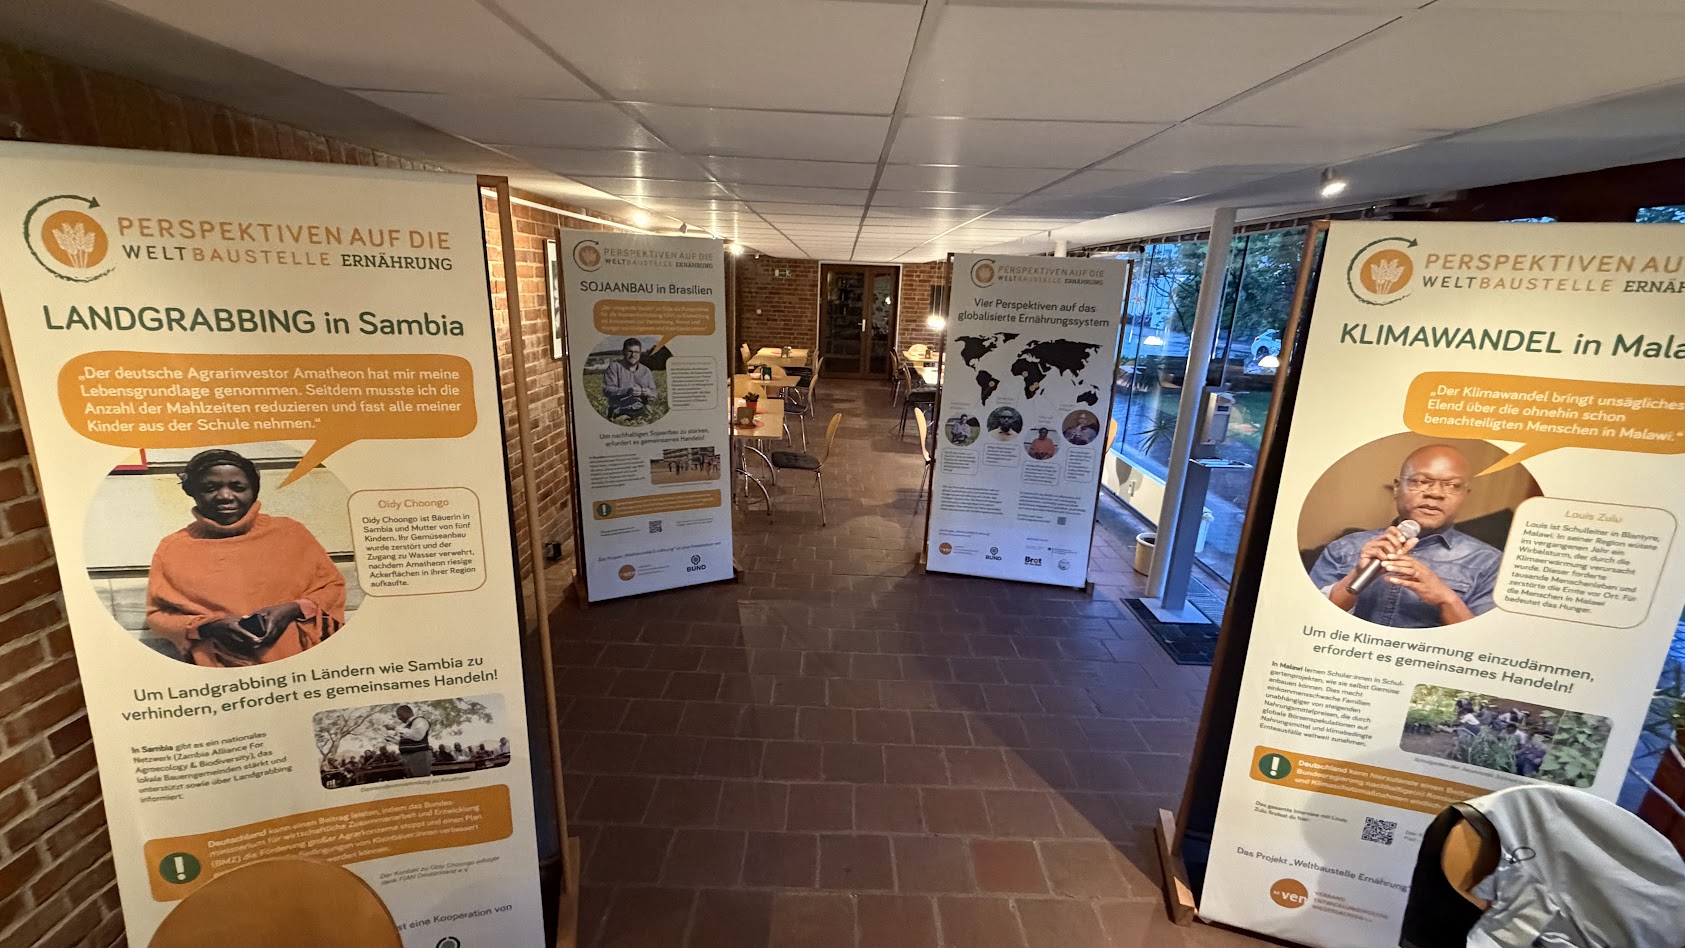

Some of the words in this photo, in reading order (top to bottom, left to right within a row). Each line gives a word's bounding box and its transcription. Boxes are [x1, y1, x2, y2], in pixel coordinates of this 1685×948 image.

[117, 218, 341, 243] PERSPEKTIVEN
[349, 228, 400, 246] AUF
[408, 230, 450, 249] DIE
[122, 245, 329, 264] WELTBAUSTELLE
[340, 254, 452, 269] ERNÄHRUNG
[1425, 254, 1635, 271] PERSPEKTIVEN
[1640, 256, 1683, 272] AU
[997, 266, 1067, 275] PERSPEKTIVEN
[580, 281, 653, 292] SOJAANBAU
[656, 284, 665, 293] in
[669, 284, 712, 294] Brasilien
[1423, 276, 1612, 290] WELTBAUSTELLE
[1623, 280, 1685, 292] ERNÄH
[974, 298, 993, 307] Vier
[995, 299, 1057, 310] Perspektiven
[1059, 302, 1076, 311] auf
[1078, 303, 1095, 312] das
[43, 306, 315, 332] LANDGRABBING
[324, 312, 349, 333] in
[359, 312, 463, 335] Sambia
[958, 311, 1015, 321] globalisierte
[1018, 314, 1109, 326] Ernährungssystem
[1340, 324, 1561, 352] KLIMAWANDEL
[1573, 334, 1601, 354] in
[1611, 335, 1685, 358] Mala
[114, 367, 182, 378] deutsche
[187, 368, 289, 381] Agrarinvestor
[293, 367, 364, 378] Amatheon
[367, 367, 389, 378] hat
[393, 369, 415, 378] mir
[419, 369, 459, 379] meine
[80, 385, 209, 398] Lebensgrundlage
[214, 387, 302, 398] genommen.
[305, 384, 362, 395] Seitdem
[365, 386, 414, 395] musste
[417, 384, 436, 395] ich
[440, 384, 459, 395] die
[1462, 387, 1549, 401] Klimawandel
[1552, 392, 1594, 406] bringt
[1597, 398, 1685, 409] unsägliches
[84, 402, 135, 413] Anzahl
[138, 402, 162, 413] der
[166, 402, 250, 413] Mahlzeiten
[254, 401, 328, 412] reduzieren
[332, 401, 356, 411] und
[360, 401, 385, 411] fast
[389, 401, 412, 411] alle
[416, 401, 461, 411] meiner
[1427, 399, 1464, 410] Elend
[1466, 402, 1496, 412] über
[1498, 404, 1519, 414] die
[1522, 406, 1578, 418] ohnehin
[1581, 411, 1625, 421] schon
[87, 420, 134, 431] Kinder
[138, 423, 164, 431] aus
[168, 419, 192, 430] der
[197, 418, 250, 430] Schule
[1424, 414, 1523, 429] benachteiligten
[1526, 421, 1598, 434] Menschen
[1601, 427, 1615, 436] in
[403, 499, 449, 507] Choongo
[410, 532, 466, 540] Gemüseanbau
[366, 553, 396, 561] Zugang
[1024, 556, 1042, 564] Brot
[1303, 625, 1325, 637] Um
[1330, 630, 1349, 641] die
[1353, 633, 1474, 661] Klimaerwärmung
[1478, 654, 1595, 681] einzudämmen,
[1313, 645, 1372, 659] erfordert
[1376, 654, 1391, 662] es
[1394, 657, 1496, 678] gemeinsames
[1501, 672, 1573, 692] Handeln!
[133, 689, 162, 701] Um
[168, 676, 287, 698] Landgrabbing
[291, 672, 306, 682] in
[311, 667, 374, 680] Ländern
[379, 663, 403, 673] wie
[408, 658, 462, 671] Sambia
[467, 658, 482, 666] zu
[121, 703, 218, 721] verhindern,
[221, 692, 298, 710] erfordert
[303, 689, 321, 698] es
[326, 680, 429, 698] gemeinsames
[434, 670, 497, 685] Handeln!
[397, 923, 407, 931] st
[409, 919, 430, 928] eine
[433, 909, 491, 921] Kooperation
[494, 904, 512, 912] von
